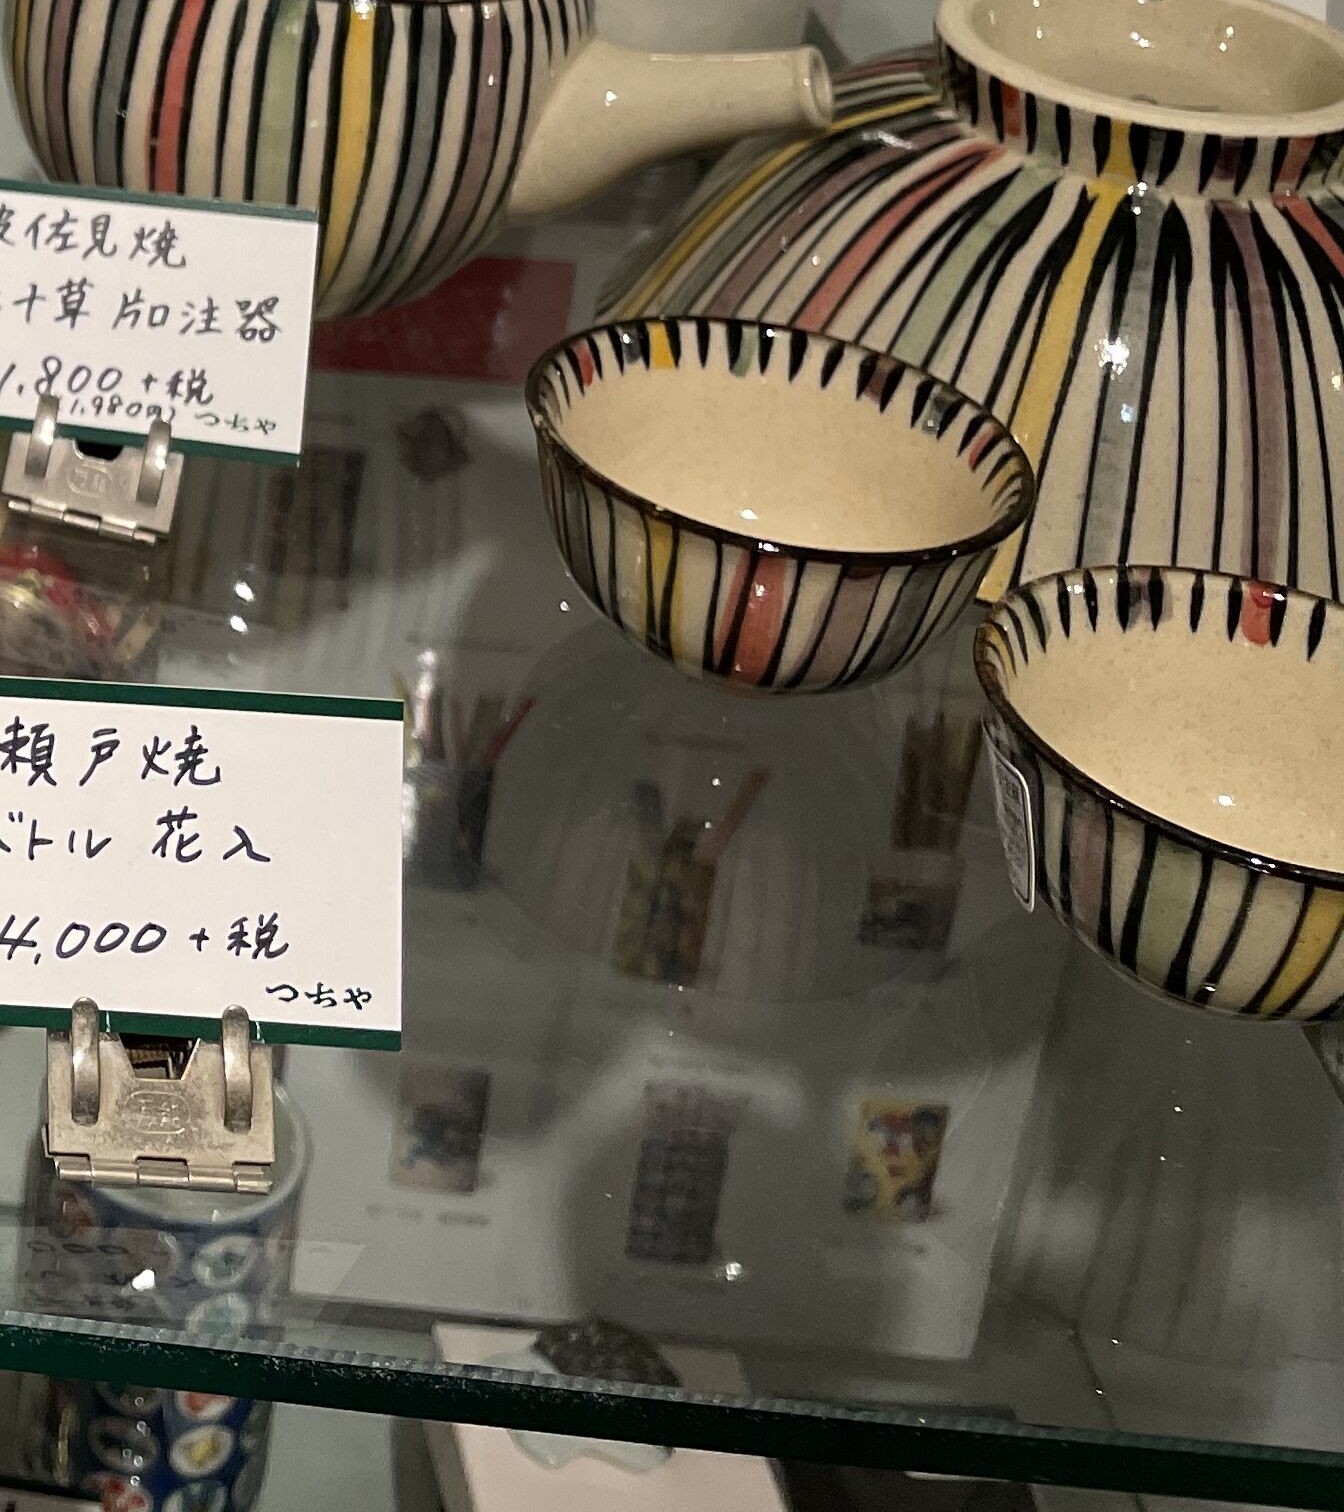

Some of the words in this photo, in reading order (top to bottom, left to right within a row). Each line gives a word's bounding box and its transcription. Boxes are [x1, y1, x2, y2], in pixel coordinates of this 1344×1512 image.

[194, 411, 279, 436] つちや
[264, 981, 374, 1011] つちや
